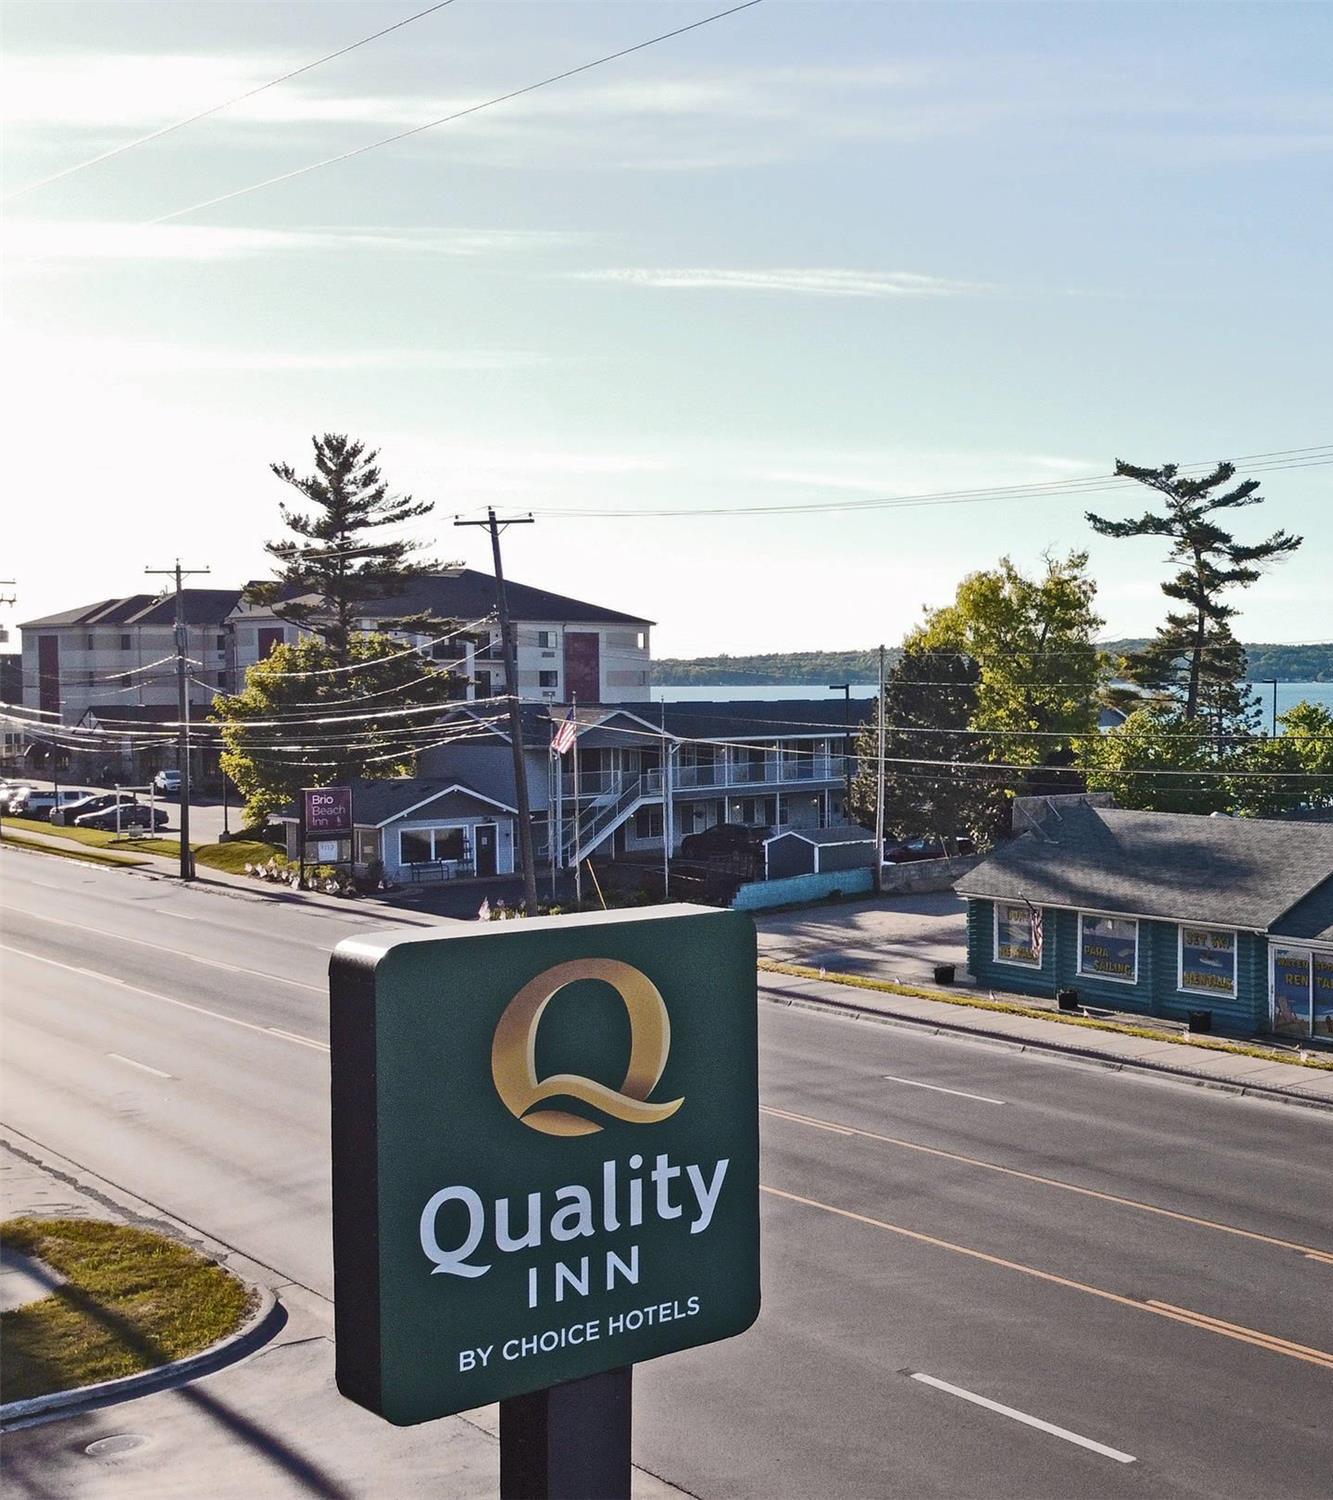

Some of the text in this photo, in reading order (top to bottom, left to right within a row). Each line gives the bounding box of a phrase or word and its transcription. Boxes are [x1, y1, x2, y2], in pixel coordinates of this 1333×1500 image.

[312, 794, 334, 805] Brio
[312, 805, 346, 816] Beach
[312, 817, 329, 826] Inn
[1084, 944, 1110, 959] PARA
[1094, 960, 1133, 976] SAILING
[1278, 956, 1309, 969] WATER
[491, 958, 686, 1137] Q
[419, 1153, 730, 1278] Quality
[528, 1245, 639, 1309] INN
[458, 1296, 701, 1373] BY CHOICE HOTELS
